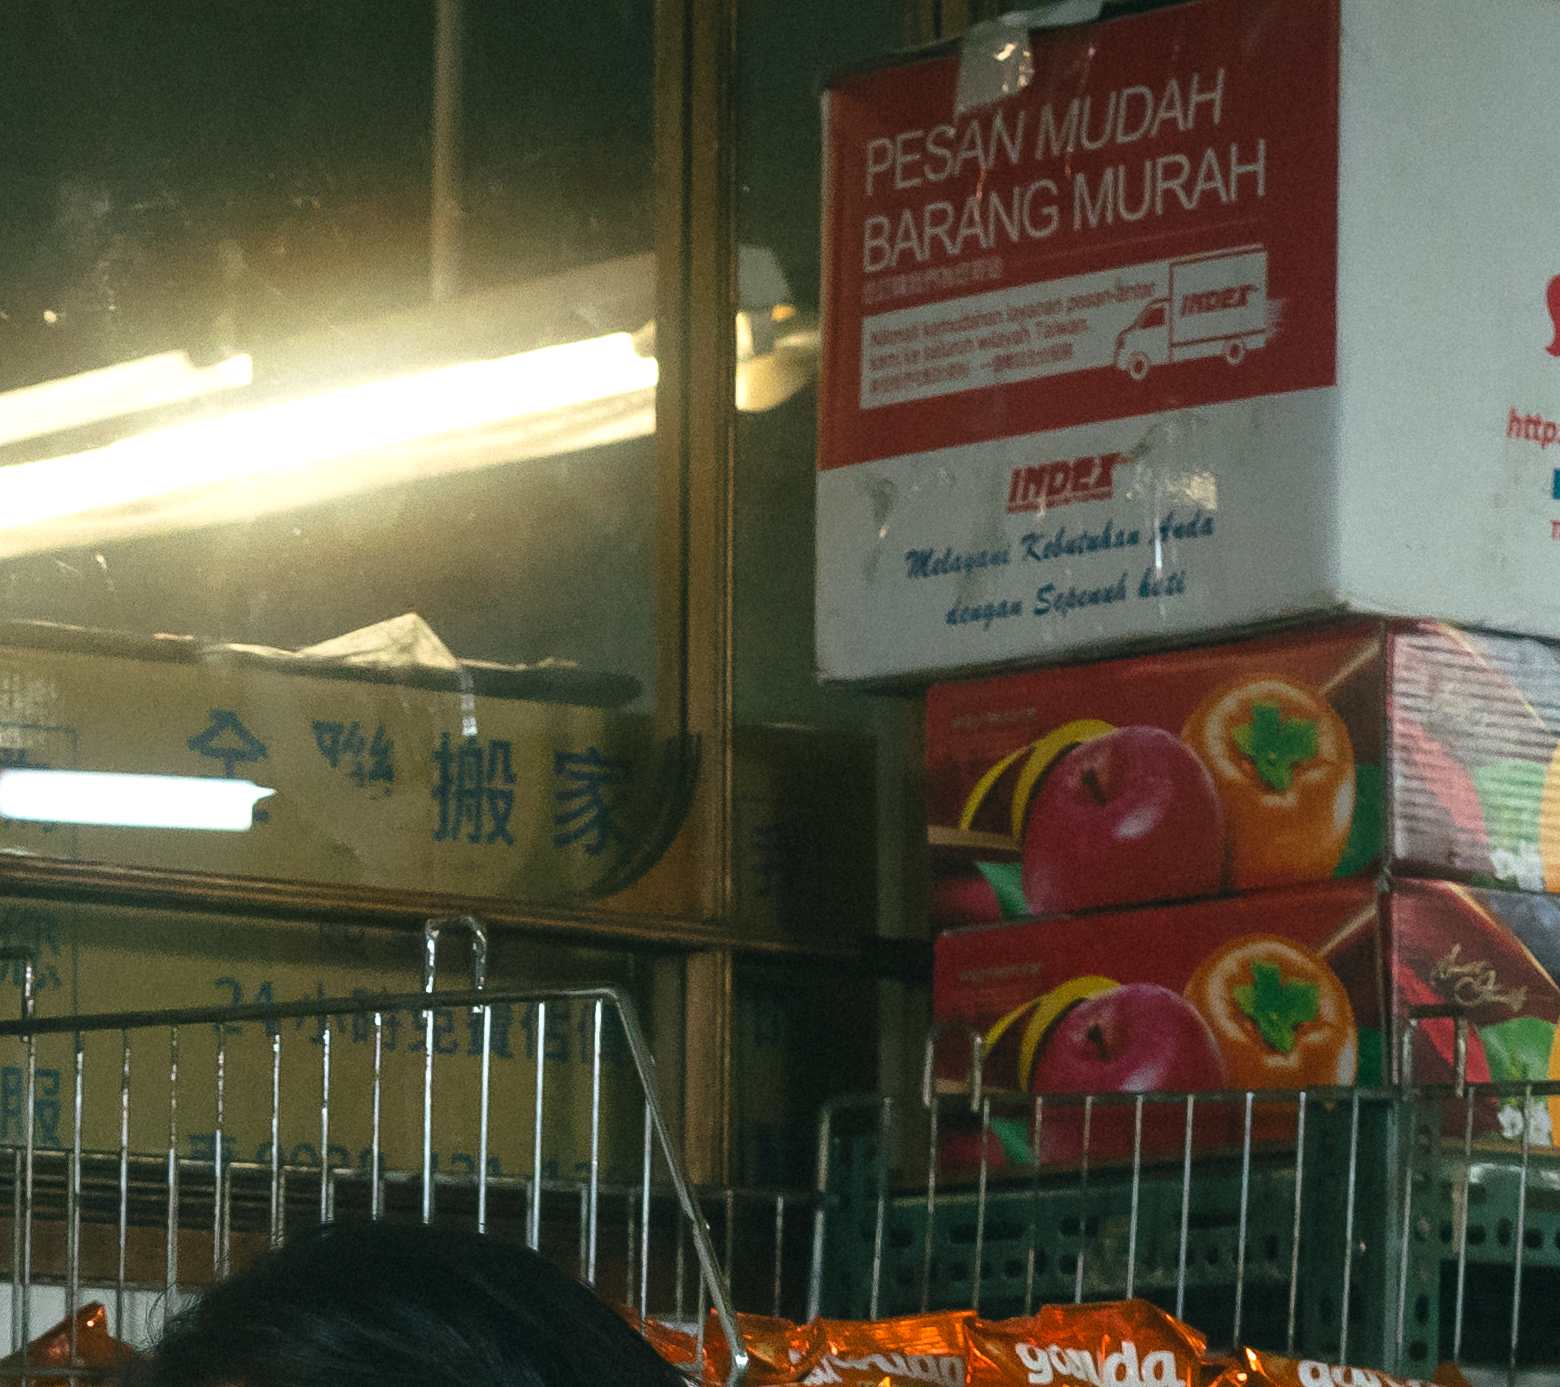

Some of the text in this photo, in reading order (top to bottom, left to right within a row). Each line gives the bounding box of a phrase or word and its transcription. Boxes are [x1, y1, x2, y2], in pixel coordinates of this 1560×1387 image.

[866, 68, 1225, 197] PESAN MUDAH
[862, 139, 1267, 274] BARANG MURAH
